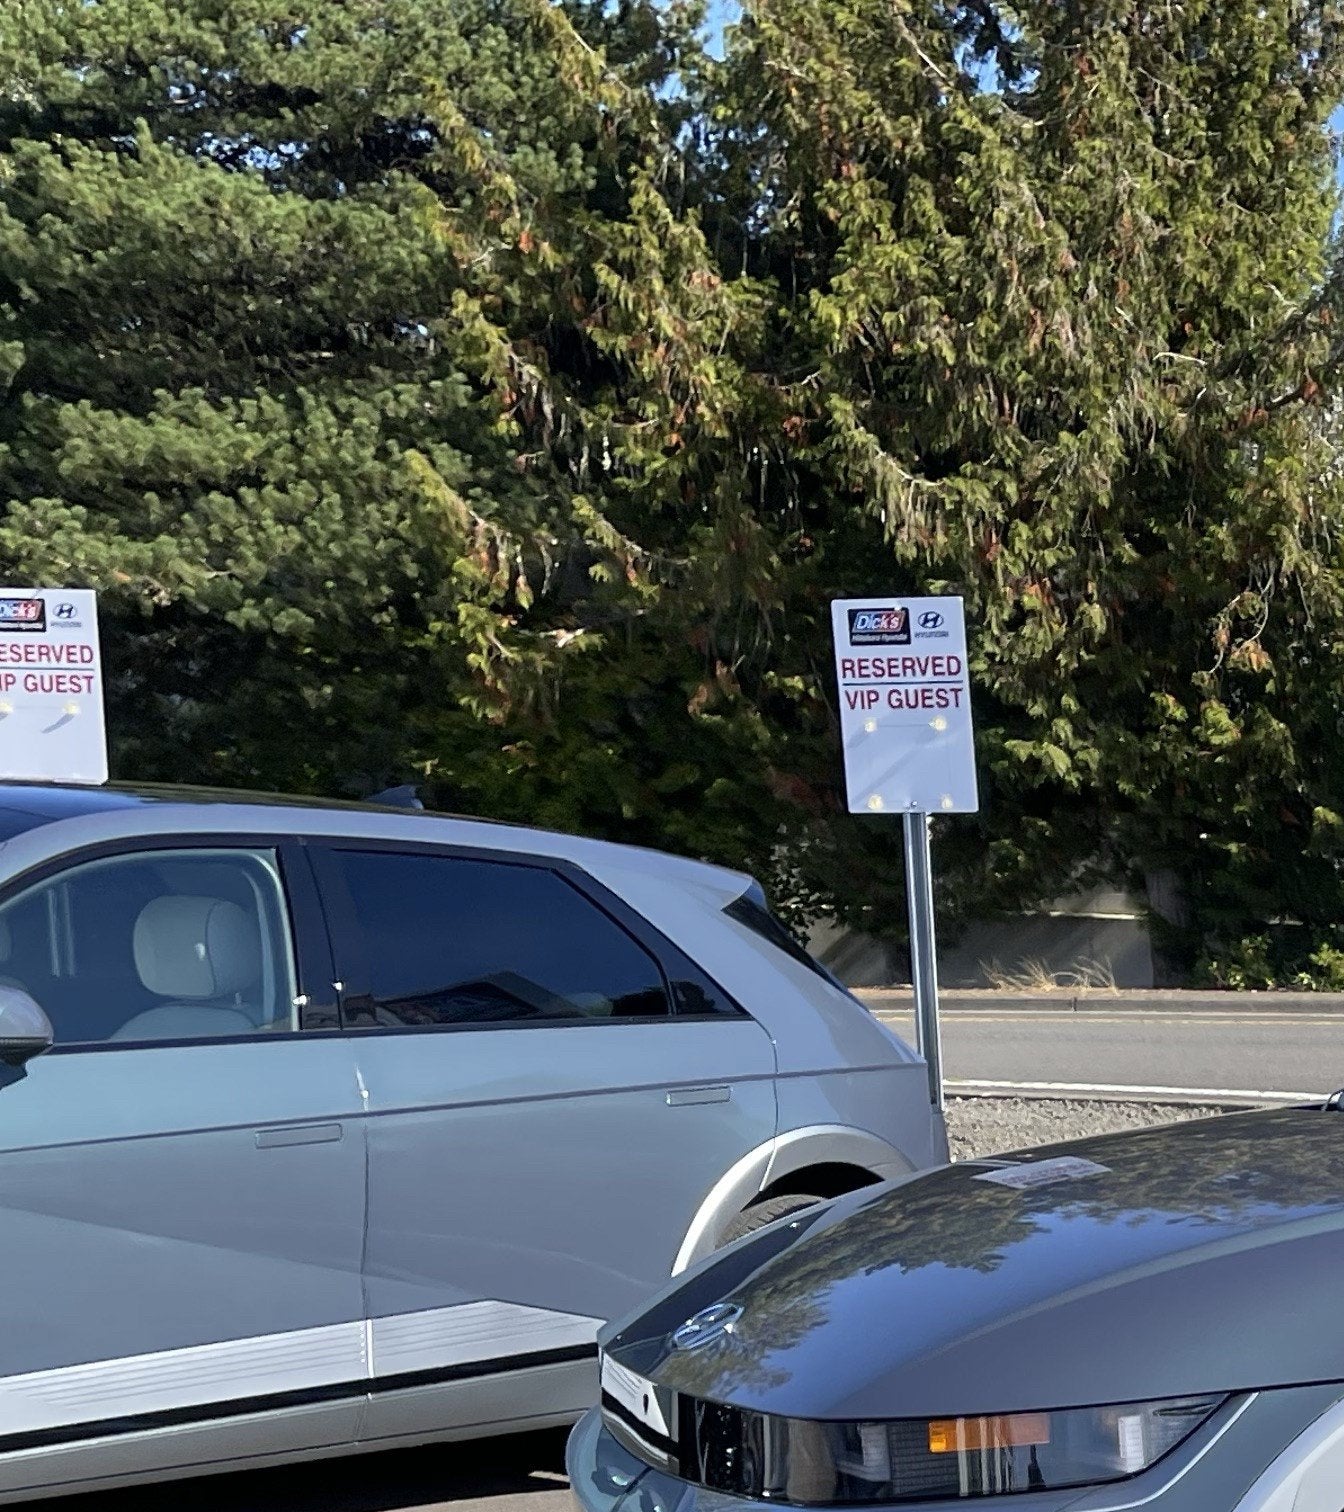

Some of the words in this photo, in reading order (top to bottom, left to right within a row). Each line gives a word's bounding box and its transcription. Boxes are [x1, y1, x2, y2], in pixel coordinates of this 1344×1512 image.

[0, 644, 94, 664] ESERVED
[841, 655, 962, 679] RESERVED
[24, 674, 94, 694] GUEST
[845, 690, 880, 710] VIP
[887, 688, 963, 709] GUEST
